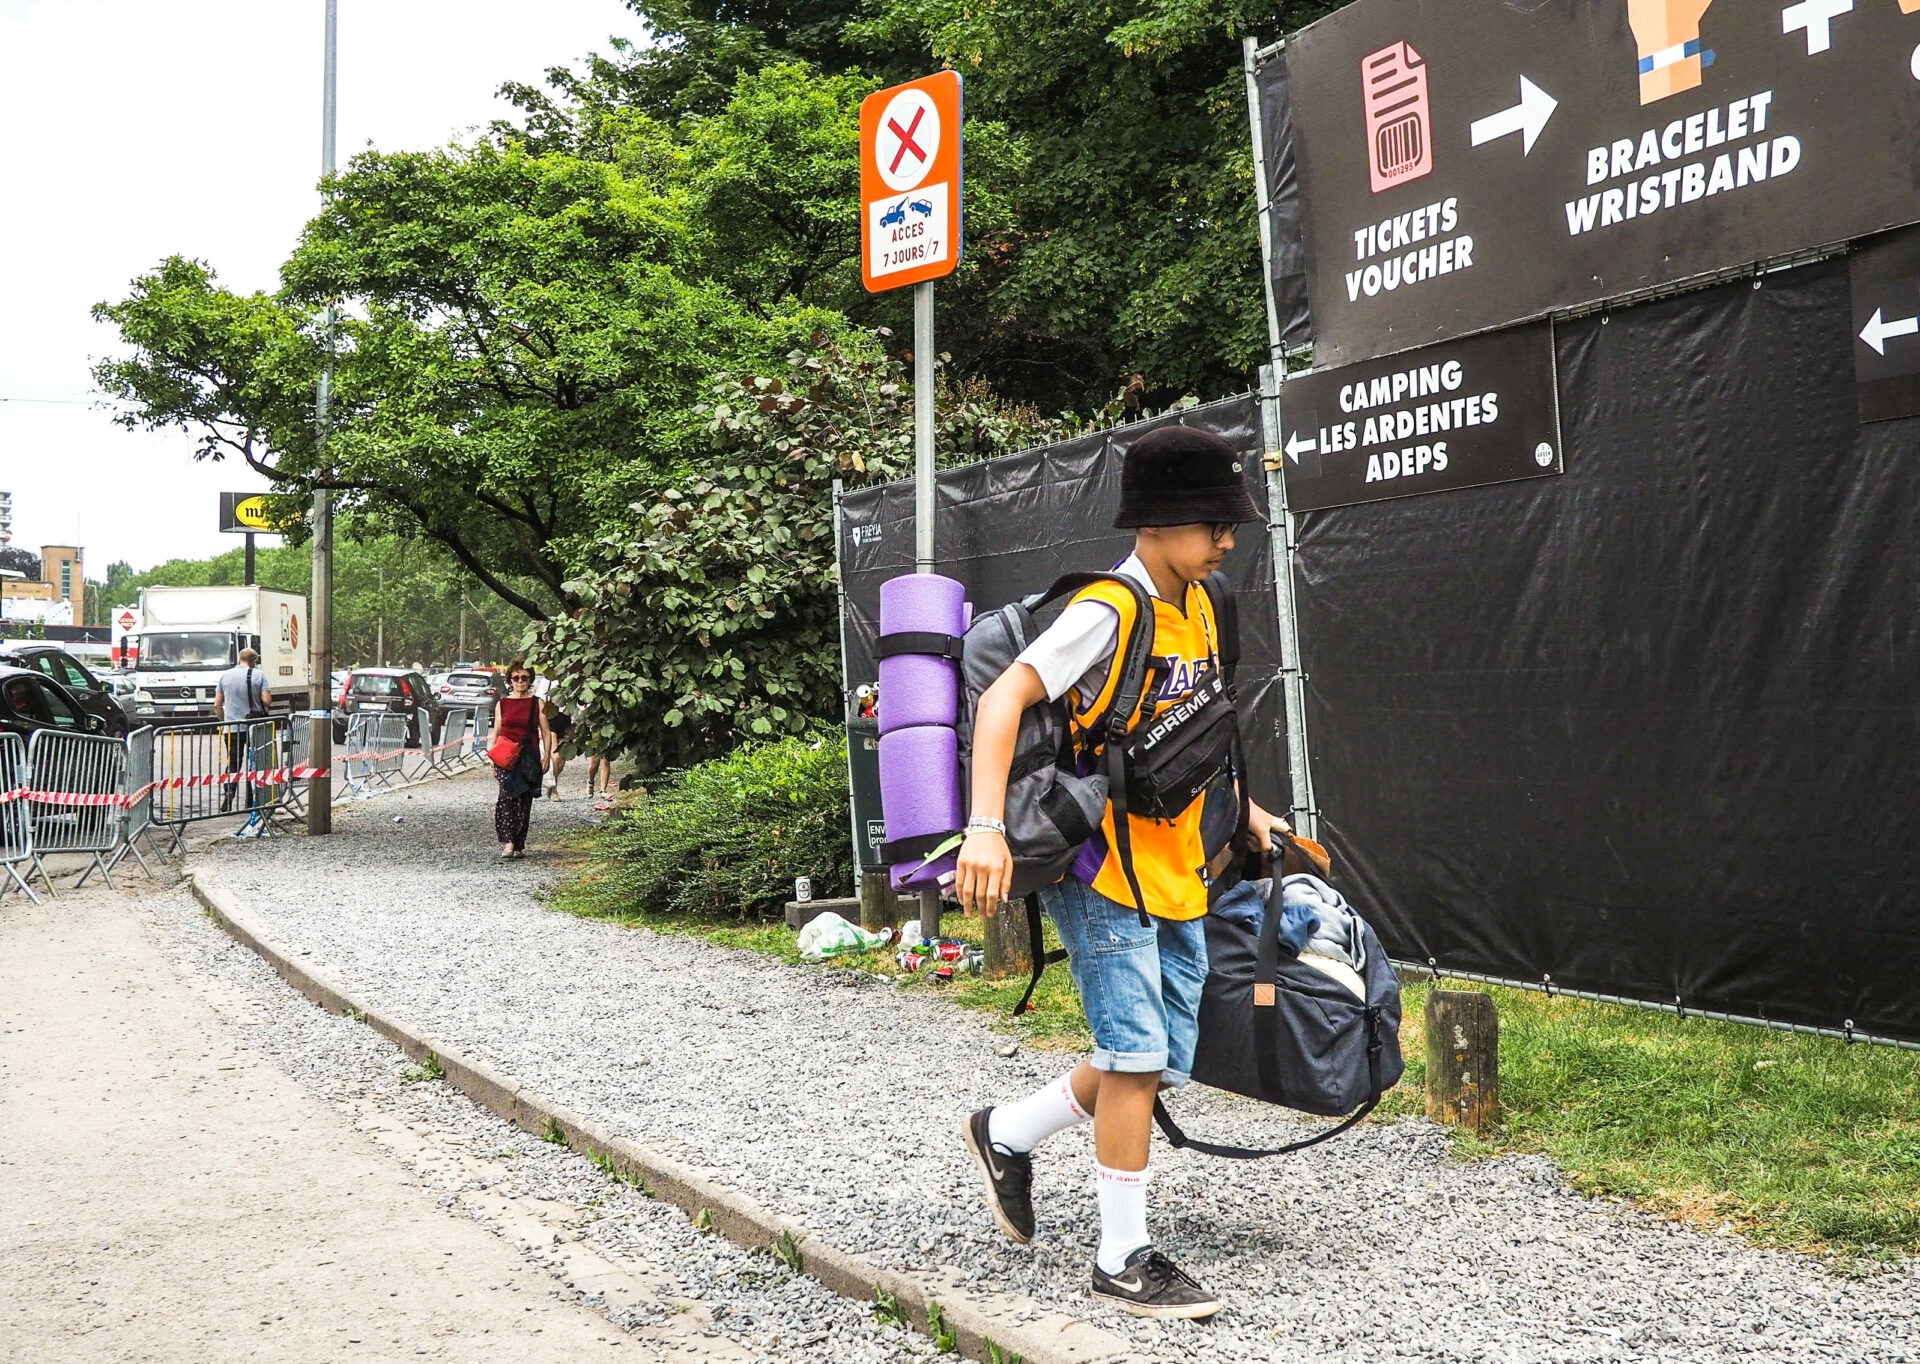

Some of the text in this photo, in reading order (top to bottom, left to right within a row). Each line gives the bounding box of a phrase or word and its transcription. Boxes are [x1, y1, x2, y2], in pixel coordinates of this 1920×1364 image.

[1586, 90, 1772, 186] BRACELET
[1388, 162, 1414, 178] 001295
[1565, 135, 1801, 236] WRISTBAND
[891, 221, 924, 243] ACCES
[1354, 197, 1458, 261] TICKETS
[883, 253, 889, 267] 7
[1345, 235, 1474, 302] VOUCHER
[1339, 360, 1463, 413] CAMPING
[1320, 392, 1498, 454] LES ARDENTES
[1365, 441, 1449, 483] ADEPS
